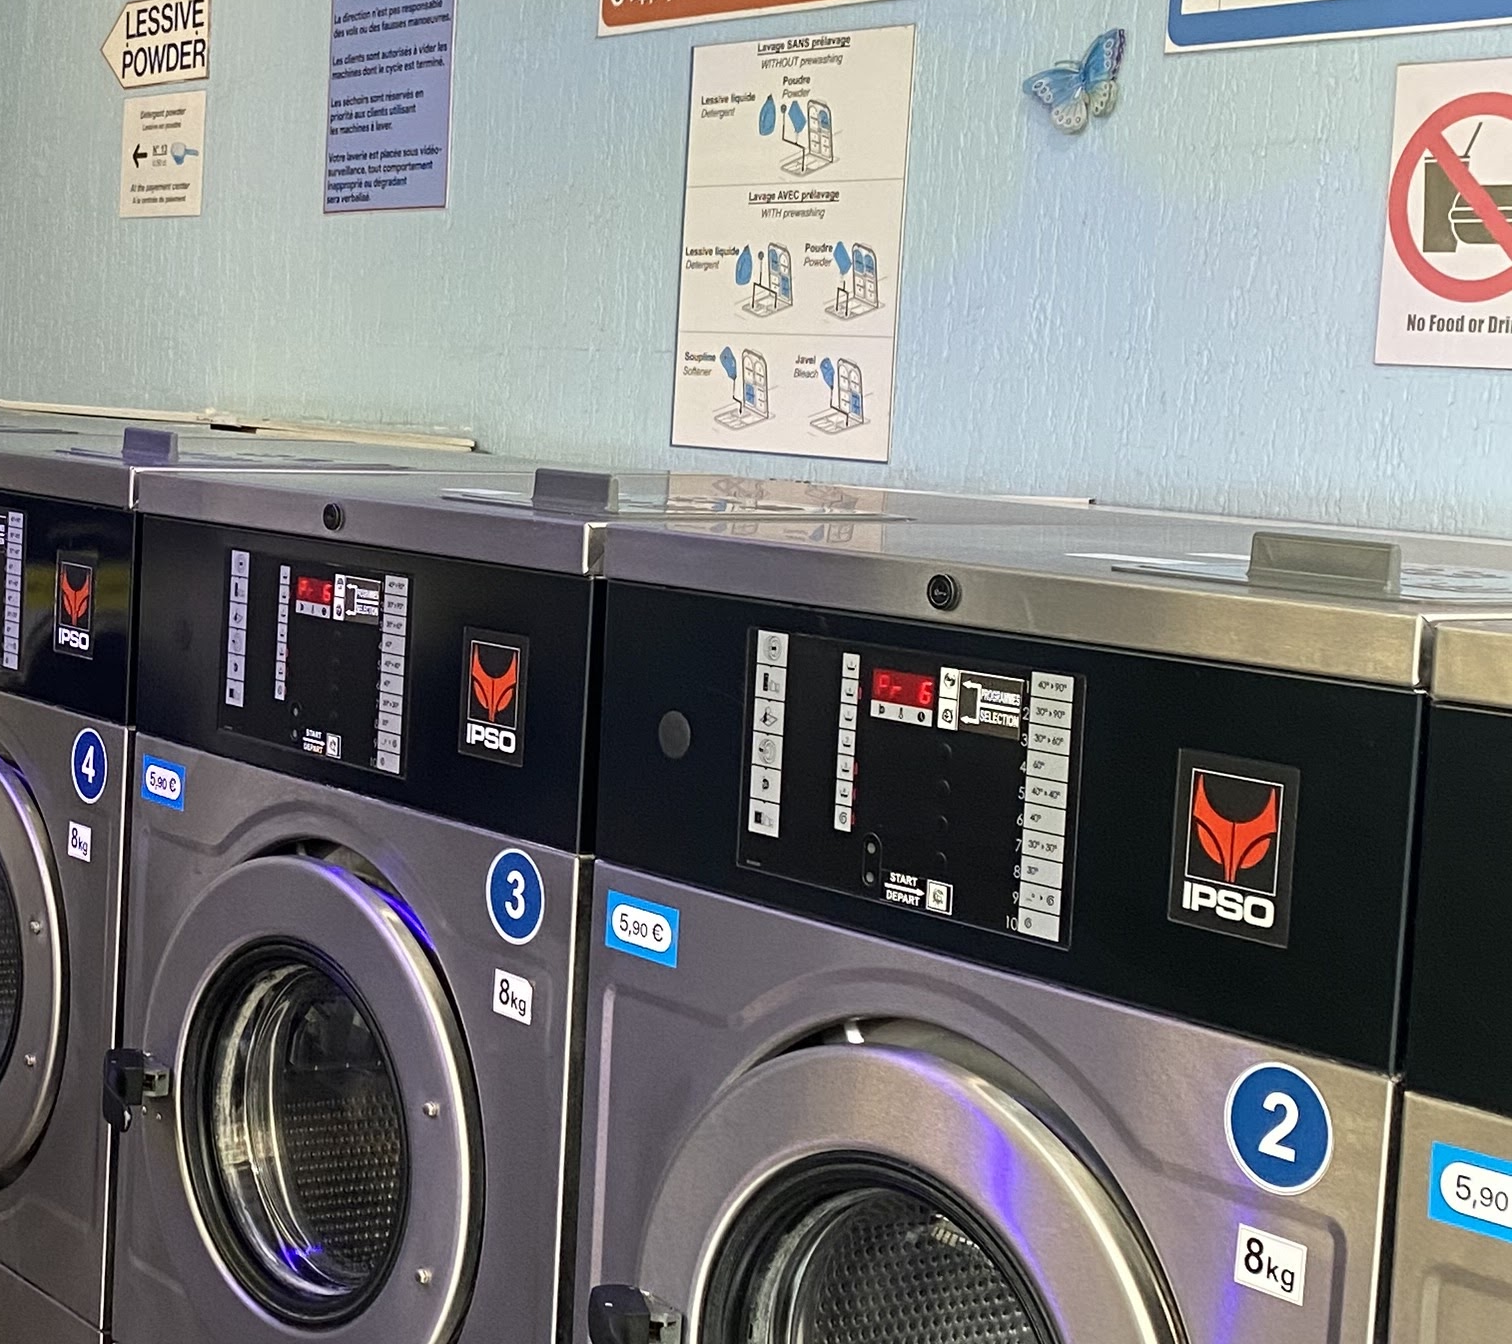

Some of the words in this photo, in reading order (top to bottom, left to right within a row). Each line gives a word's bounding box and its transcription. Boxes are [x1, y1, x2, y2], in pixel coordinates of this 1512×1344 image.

[758, 42, 784, 53] Lavage
[787, 39, 809, 49] SANS
[812, 35, 850, 49] prélavage
[122, 38, 206, 79] POWDER
[761, 57, 799, 69] WITHOUT
[800, 54, 843, 67] prewashing
[783, 76, 810, 85] Poudre
[701, 95, 729, 105] Lessive
[731, 92, 756, 103] liquide
[701, 108, 735, 119] Detergent
[1407, 314, 1425, 332] No
[1429, 314, 1464, 332] Food
[1469, 318, 1484, 333] or
[795, 355, 816, 365] Javel
[794, 369, 818, 379] Bleach
[58, 628, 89, 651] IPSO
[981, 688, 1021, 707] PROGRAMMES
[980, 709, 1019, 728] SELECTION
[466, 723, 516, 754] IPSO
[82, 746, 96, 784] 4
[149, 772, 168, 791] 5,90
[168, 778, 176, 793] €
[71, 827, 88, 856] 8kg
[890, 872, 918, 887] START
[505, 870, 526, 919] 3
[886, 889, 920, 906] DEPART
[1182, 880, 1275, 928] IPSO
[619, 913, 647, 938] 5,90
[653, 924, 663, 942] €
[499, 979, 526, 1016] 8kg
[1258, 1091, 1299, 1163] 2
[1455, 1174, 1509, 1211] 5,90
[1244, 1237, 1295, 1293] 8kg
